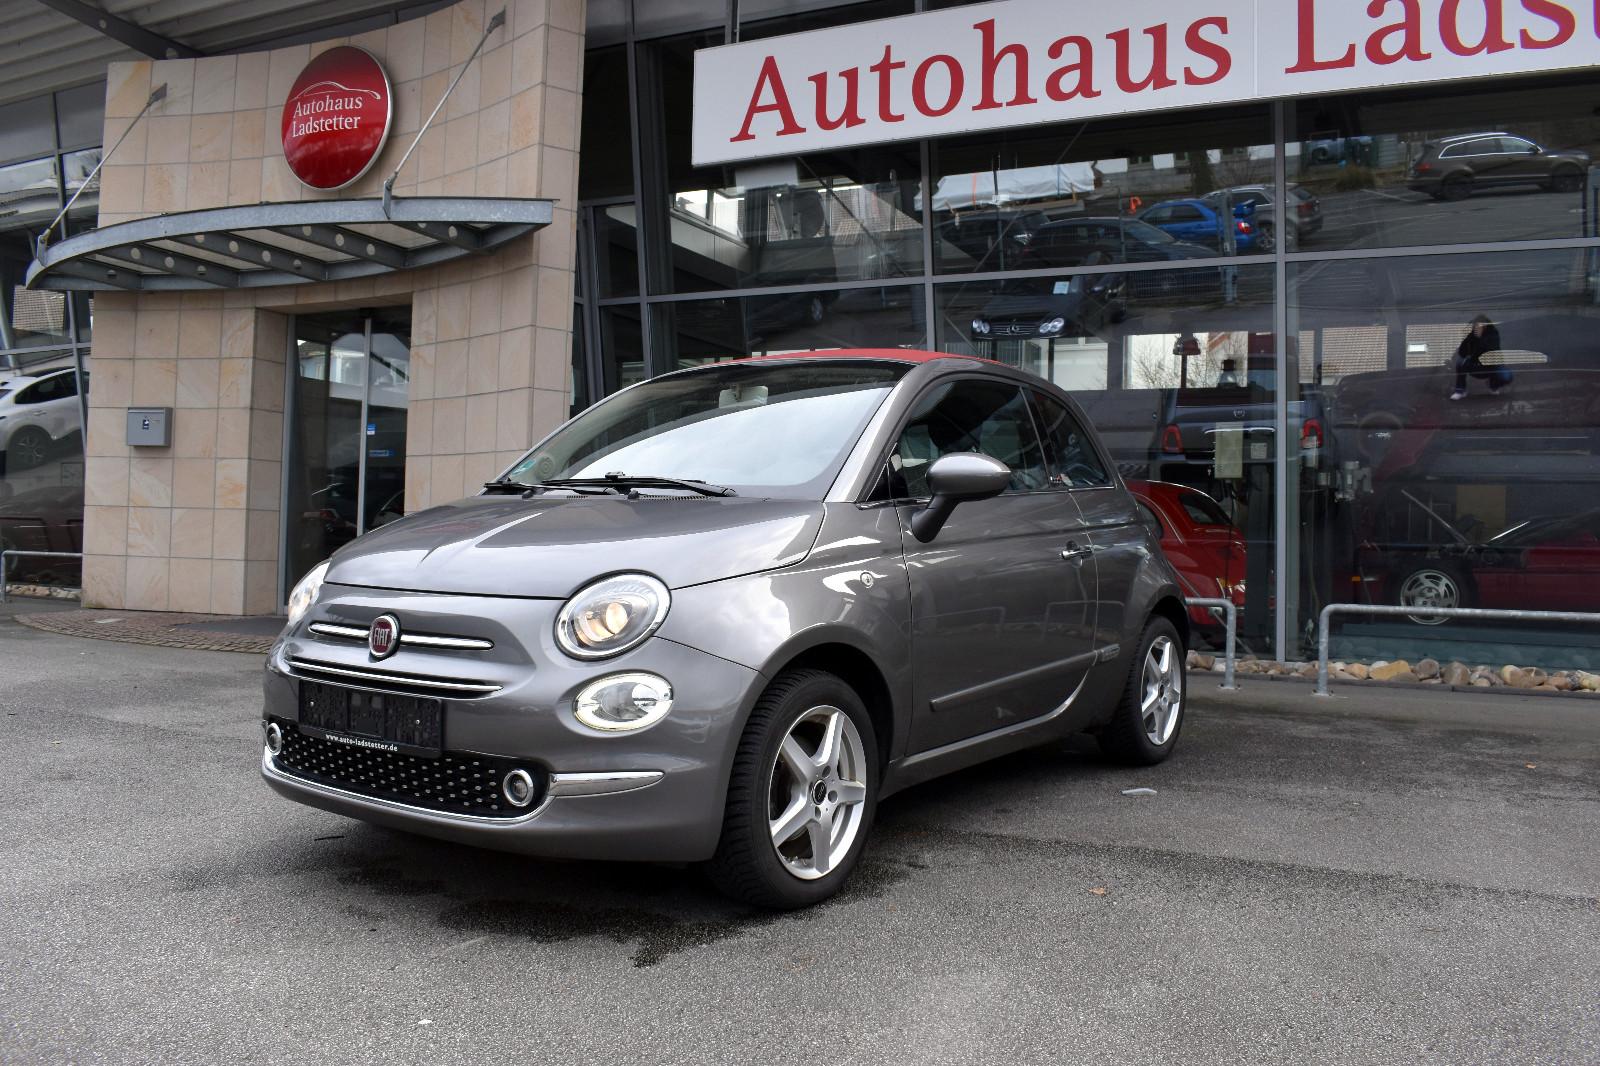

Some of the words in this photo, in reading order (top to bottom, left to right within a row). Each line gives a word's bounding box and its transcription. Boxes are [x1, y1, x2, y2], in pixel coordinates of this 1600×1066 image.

[729, 16, 1232, 142] Autohaus
[1284, 0, 1600, 75] Lads
[293, 95, 363, 118] Autohaus
[292, 115, 361, 138] Ladstetter
[373, 627, 390, 646] FIAT
[325, 734, 398, 752] www.auto-ladstetter.de
